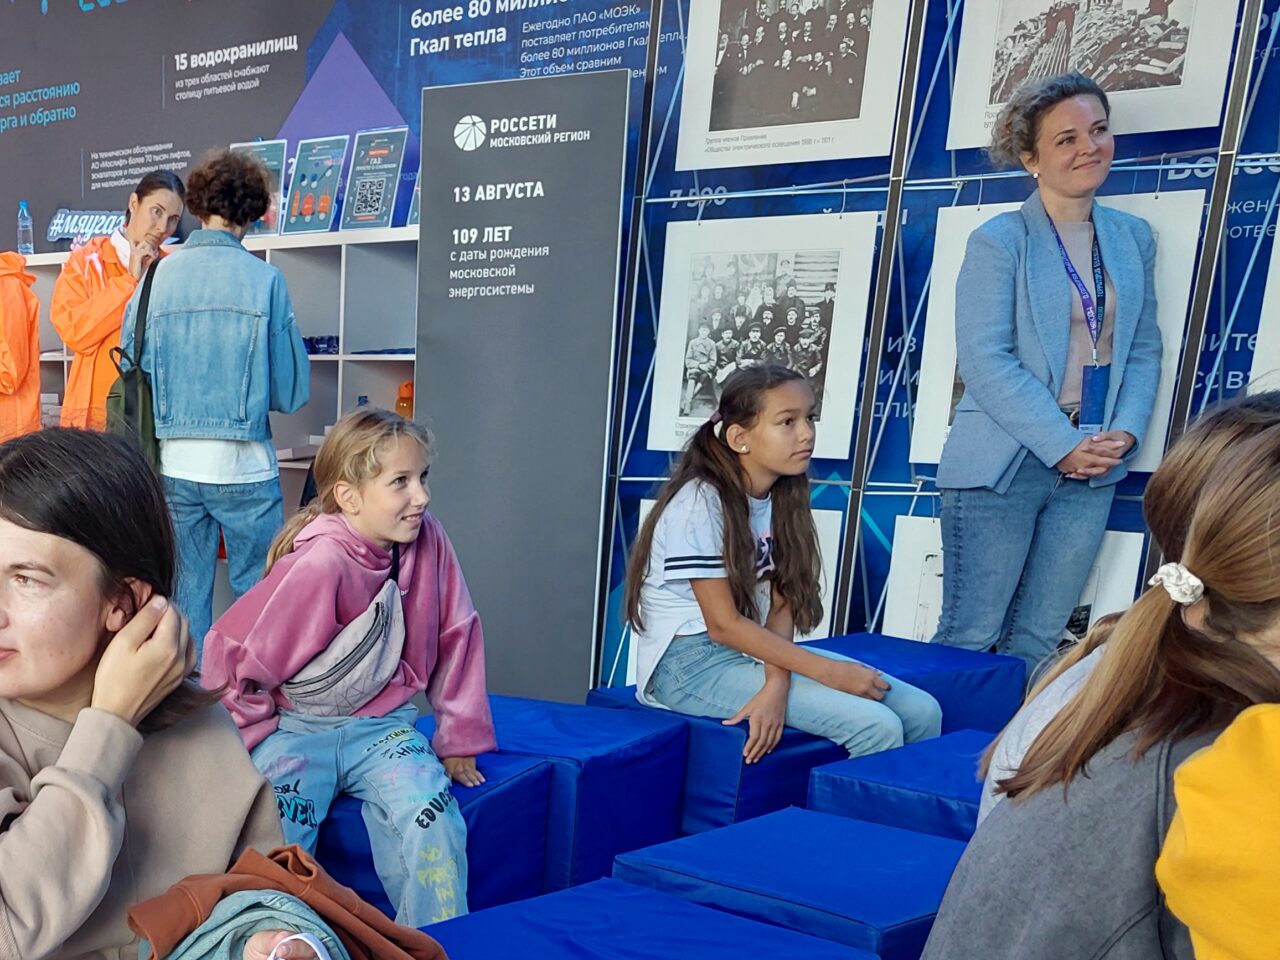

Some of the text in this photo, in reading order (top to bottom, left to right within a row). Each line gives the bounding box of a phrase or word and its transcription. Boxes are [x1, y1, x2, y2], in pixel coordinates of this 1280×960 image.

[411, 0, 491, 29] более 80
[523, 5, 641, 33] Ежегодно ПАО «МОЭК»
[410, 26, 507, 57] Гкал тепла
[521, 32, 576, 49] поставляет
[174, 35, 298, 71] 15 водохранилищ
[520, 48, 550, 63] более
[552, 47, 565, 59] 80
[567, 41, 625, 57] миллионов
[175, 64, 270, 88] из трех областей снабжают
[520, 55, 622, 79] Этот объем сравним
[12, 81, 80, 107] расстоянию
[175, 78, 259, 101] столицу питьевой водой
[20, 115, 28, 126] и
[29, 106, 76, 126] обратно
[490, 114, 557, 133] РОССЕТИ
[490, 130, 591, 148] МОСКОВСКИЙ РЕГИОН
[454, 181, 544, 202] 13 АВГУСТА
[452, 226, 512, 244] 109 ЛЕТ
[450, 246, 549, 262] с даты рождения
[449, 265, 516, 280] московской
[449, 283, 535, 300] энергосистемы
